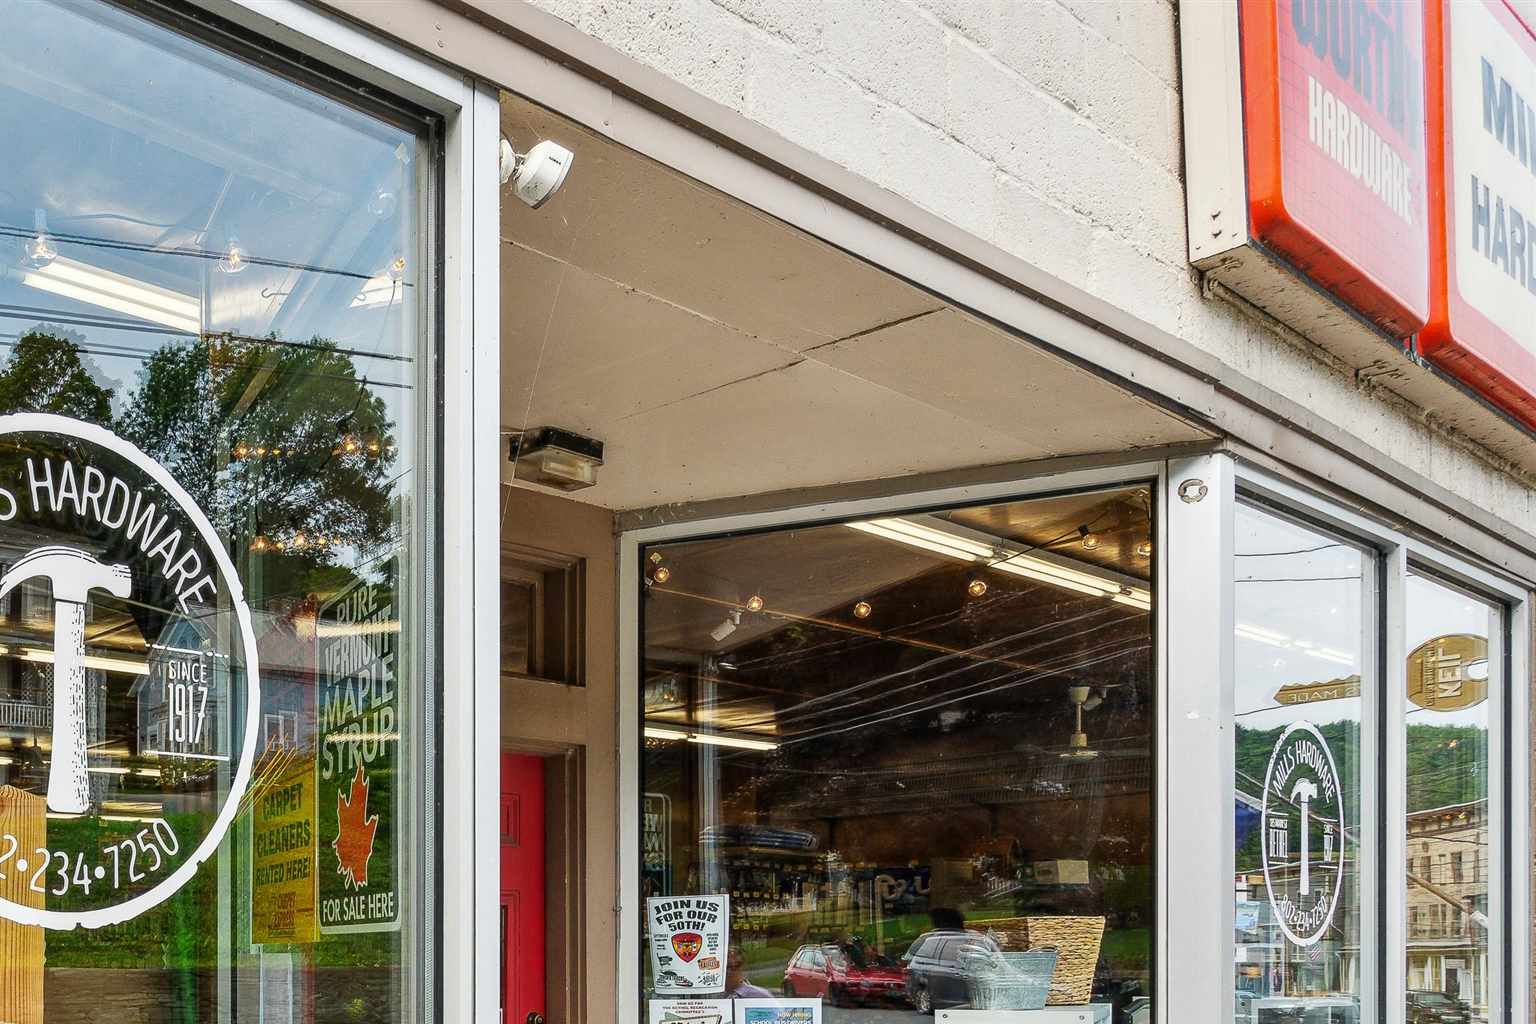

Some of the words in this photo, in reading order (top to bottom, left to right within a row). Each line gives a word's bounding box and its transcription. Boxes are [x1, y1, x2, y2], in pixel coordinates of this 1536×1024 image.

[1308, 75, 1412, 225] HARDWARE
[27, 458, 217, 614] HARDWARE
[337, 583, 378, 627] PURE
[325, 604, 391, 687] VERMONT
[169, 660, 208, 684] SINCE
[169, 683, 208, 744] 1917
[323, 653, 393, 733] MAPLE
[322, 706, 394, 779] SYRUP
[1273, 746, 1295, 797] MILLS
[1295, 740, 1335, 803] HARDWARE
[263, 783, 303, 818] CARPET
[257, 820, 310, 858] CLEANERS
[287, 857, 310, 880] HERE!
[323, 898, 340, 922] FOR
[343, 895, 365, 921] SALE
[368, 891, 394, 919] HERE
[654, 900, 691, 915] JOIN
[696, 900, 719, 912] US
[656, 911, 683, 925] FOR
[687, 910, 717, 923] OUR
[668, 921, 705, 931] 50TH!
